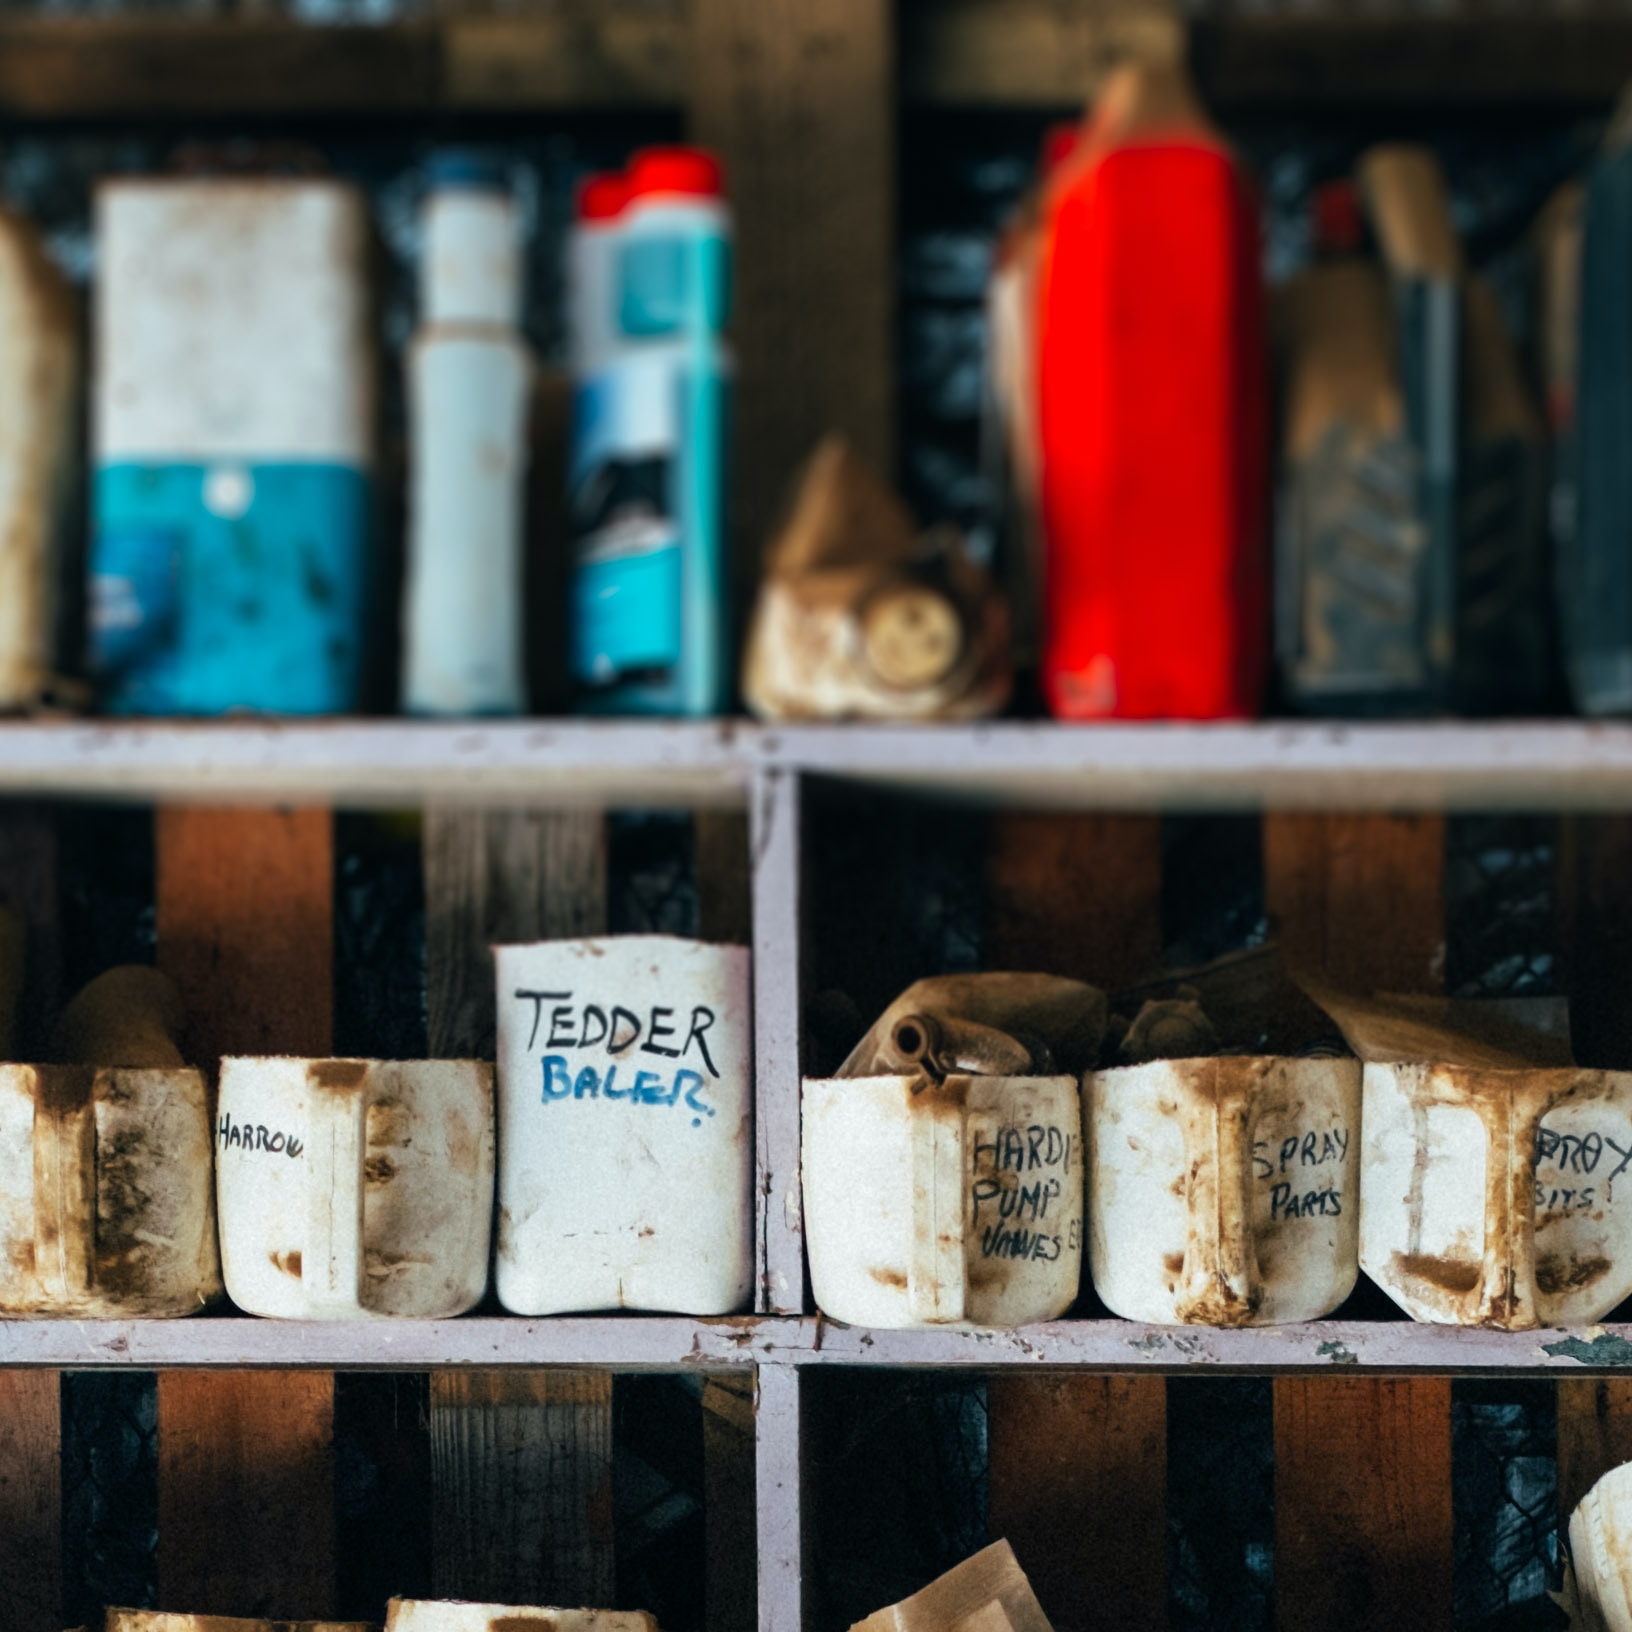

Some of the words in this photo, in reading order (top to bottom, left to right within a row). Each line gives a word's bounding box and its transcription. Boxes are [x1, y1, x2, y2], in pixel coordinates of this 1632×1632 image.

[515, 989, 720, 1078] TEDDER
[217, 1112, 305, 1159] HARROW
[1252, 1129, 1349, 1181] SPRAY
[971, 1178, 1061, 1229] PUMP
[1269, 1182, 1343, 1220] PARTS
